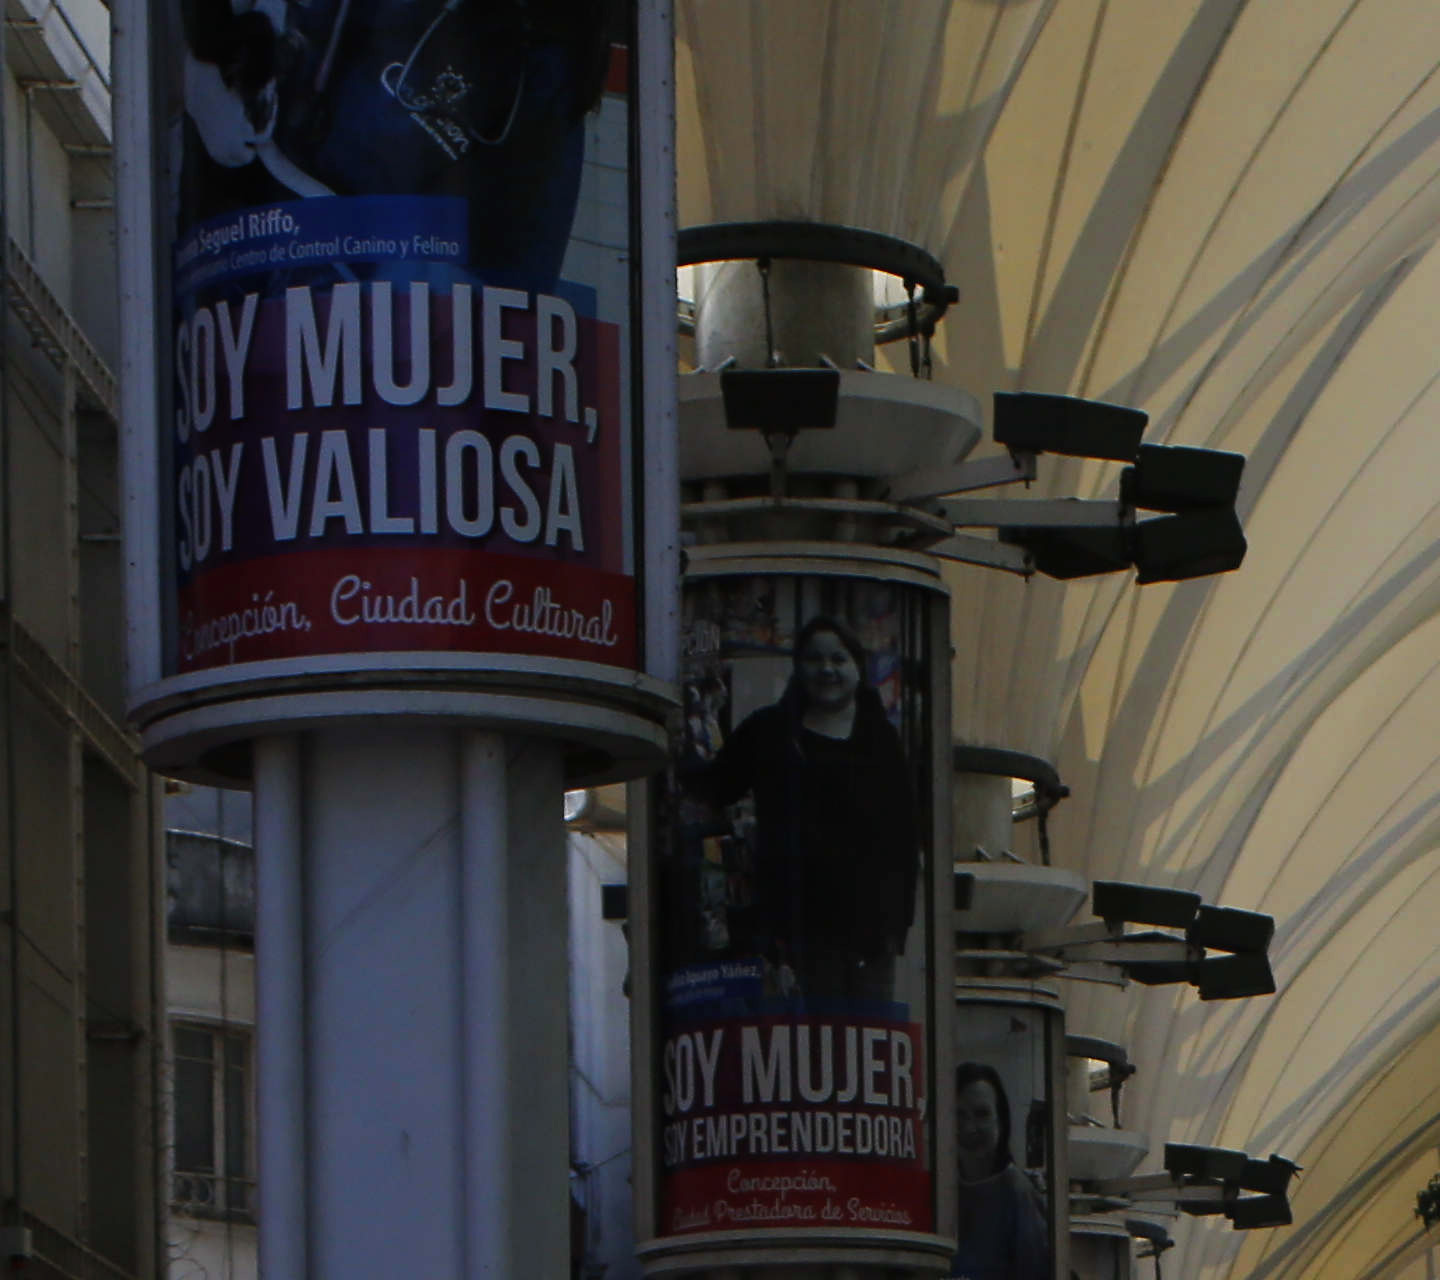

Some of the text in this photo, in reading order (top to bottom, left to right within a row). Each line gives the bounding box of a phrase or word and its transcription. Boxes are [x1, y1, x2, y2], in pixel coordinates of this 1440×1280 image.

[248, 208, 301, 236] Riffo,
[270, 242, 287, 261] de
[288, 235, 340, 260] Control
[343, 234, 398, 256] Canino
[400, 240, 409, 259] y
[413, 234, 461, 257] Felino
[175, 280, 598, 445] SOY MUJER,
[178, 427, 585, 572] SOY VALIOSA
[183, 590, 312, 663] Concepción,
[330, 573, 476, 627] Ciudad
[485, 577, 617, 648] Cultural
[664, 1023, 927, 1121] SOY MUJER,
[664, 1110, 917, 1168] SOY EMPRENDEDORA
[713, 1200, 816, 1222] Prestadora
[821, 1199, 844, 1220] de
